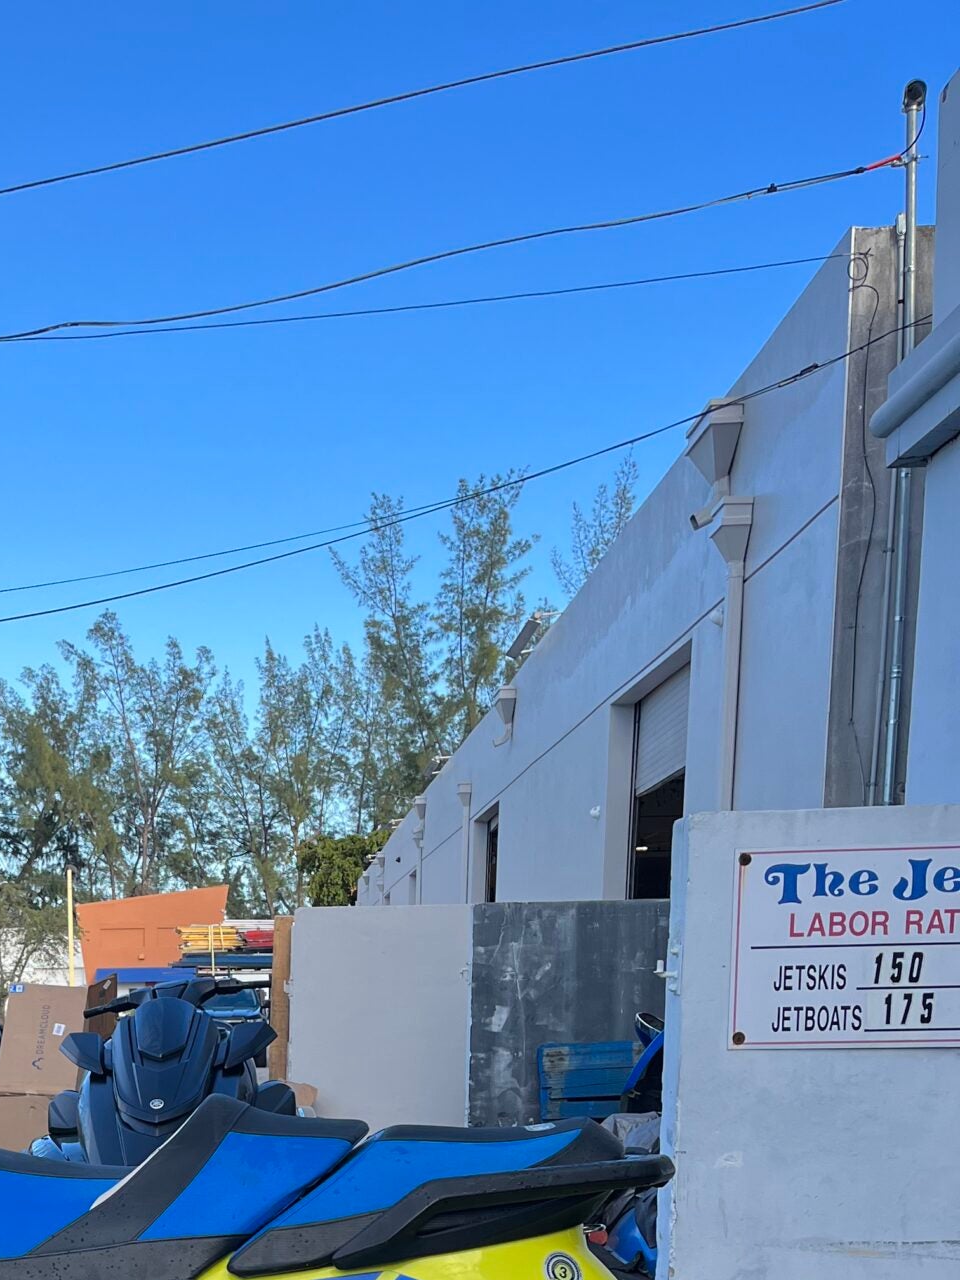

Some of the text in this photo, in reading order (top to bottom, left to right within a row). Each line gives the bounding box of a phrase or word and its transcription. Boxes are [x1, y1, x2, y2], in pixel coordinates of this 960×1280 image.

[765, 858, 960, 904] The Je
[789, 908, 960, 937] LABOR RAT
[773, 952, 924, 992] JETSKIS 150
[35, 1004, 50, 1055] DREAMCLOUD
[771, 993, 934, 1032] JETBOATS 175
[558, 1266, 568, 1279] 3
